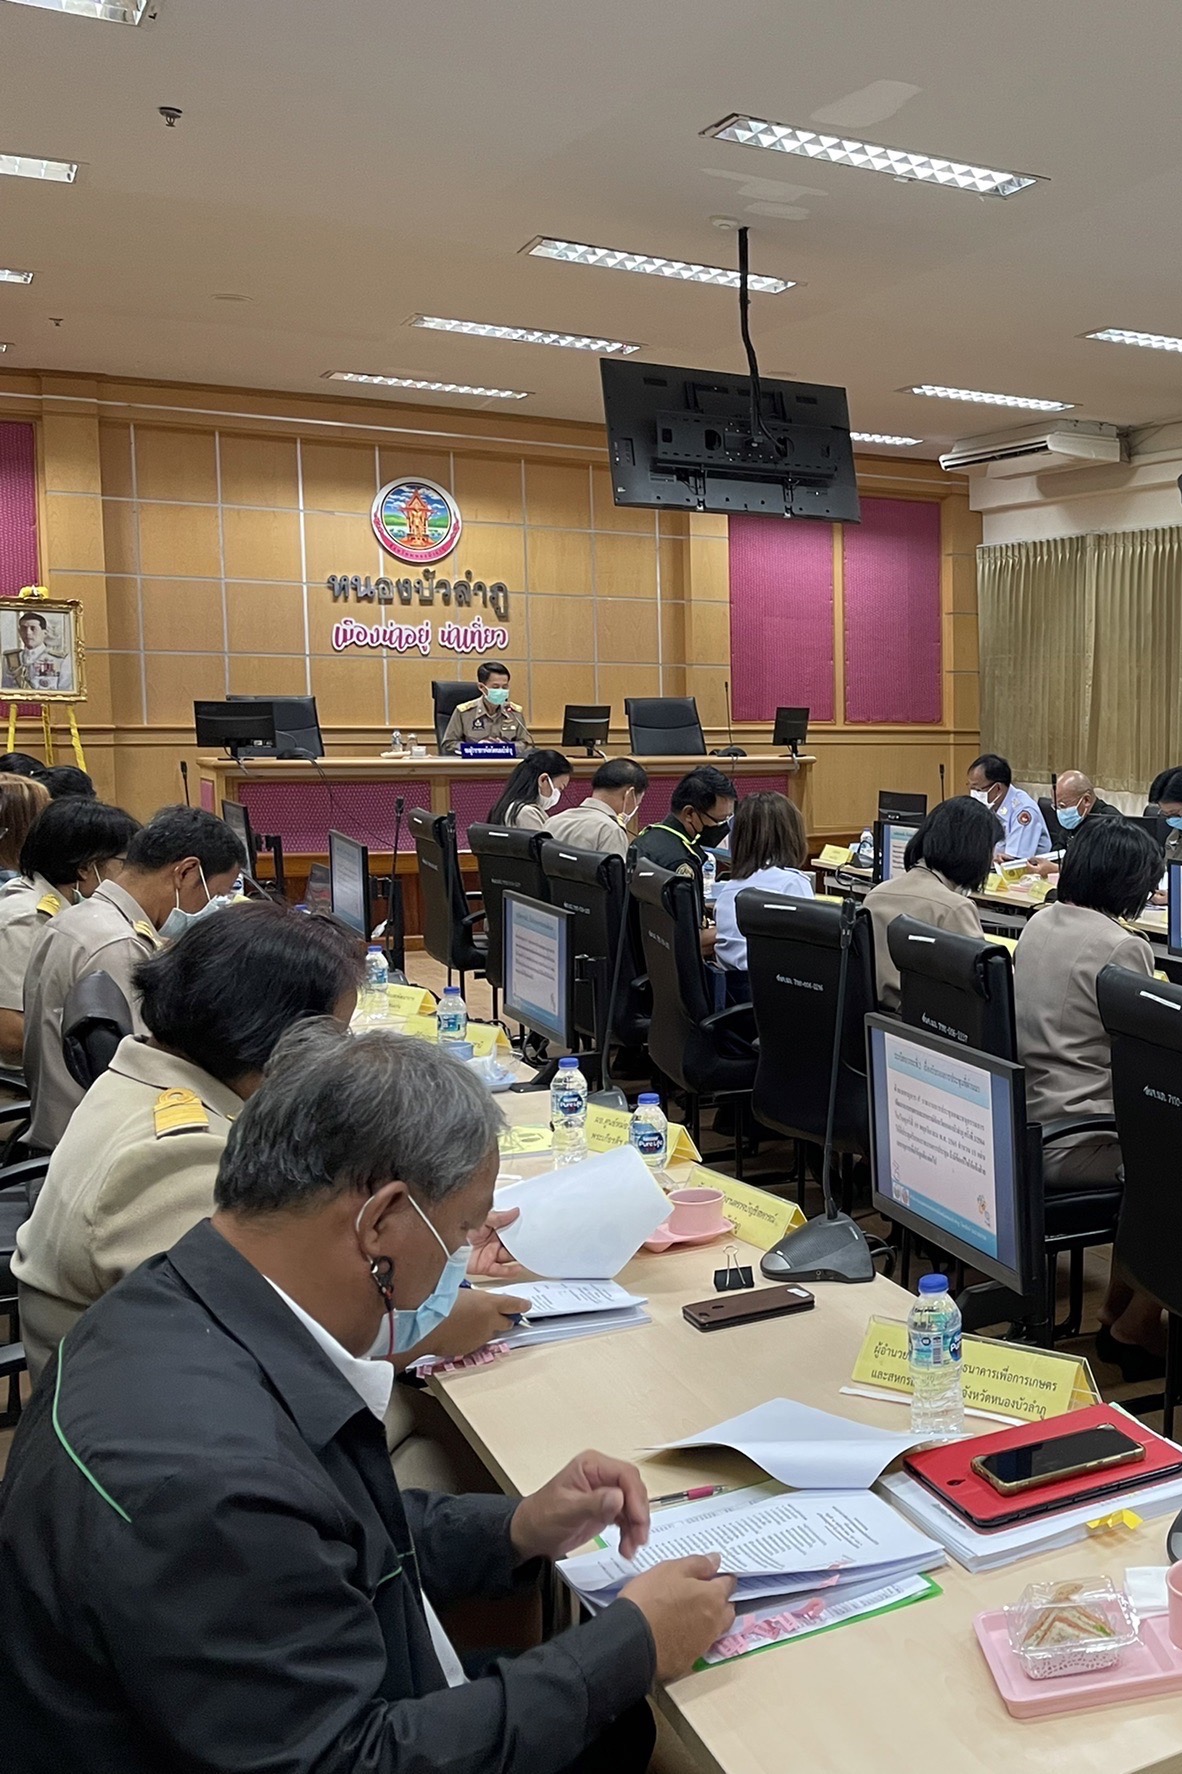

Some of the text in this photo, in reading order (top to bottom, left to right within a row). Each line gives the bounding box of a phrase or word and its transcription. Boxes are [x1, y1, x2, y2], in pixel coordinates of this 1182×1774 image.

[328, 569, 509, 621] หนองบัวลำภู
[333, 617, 509, 654] เมืองน่าอยู่ น่าเที่ยว
